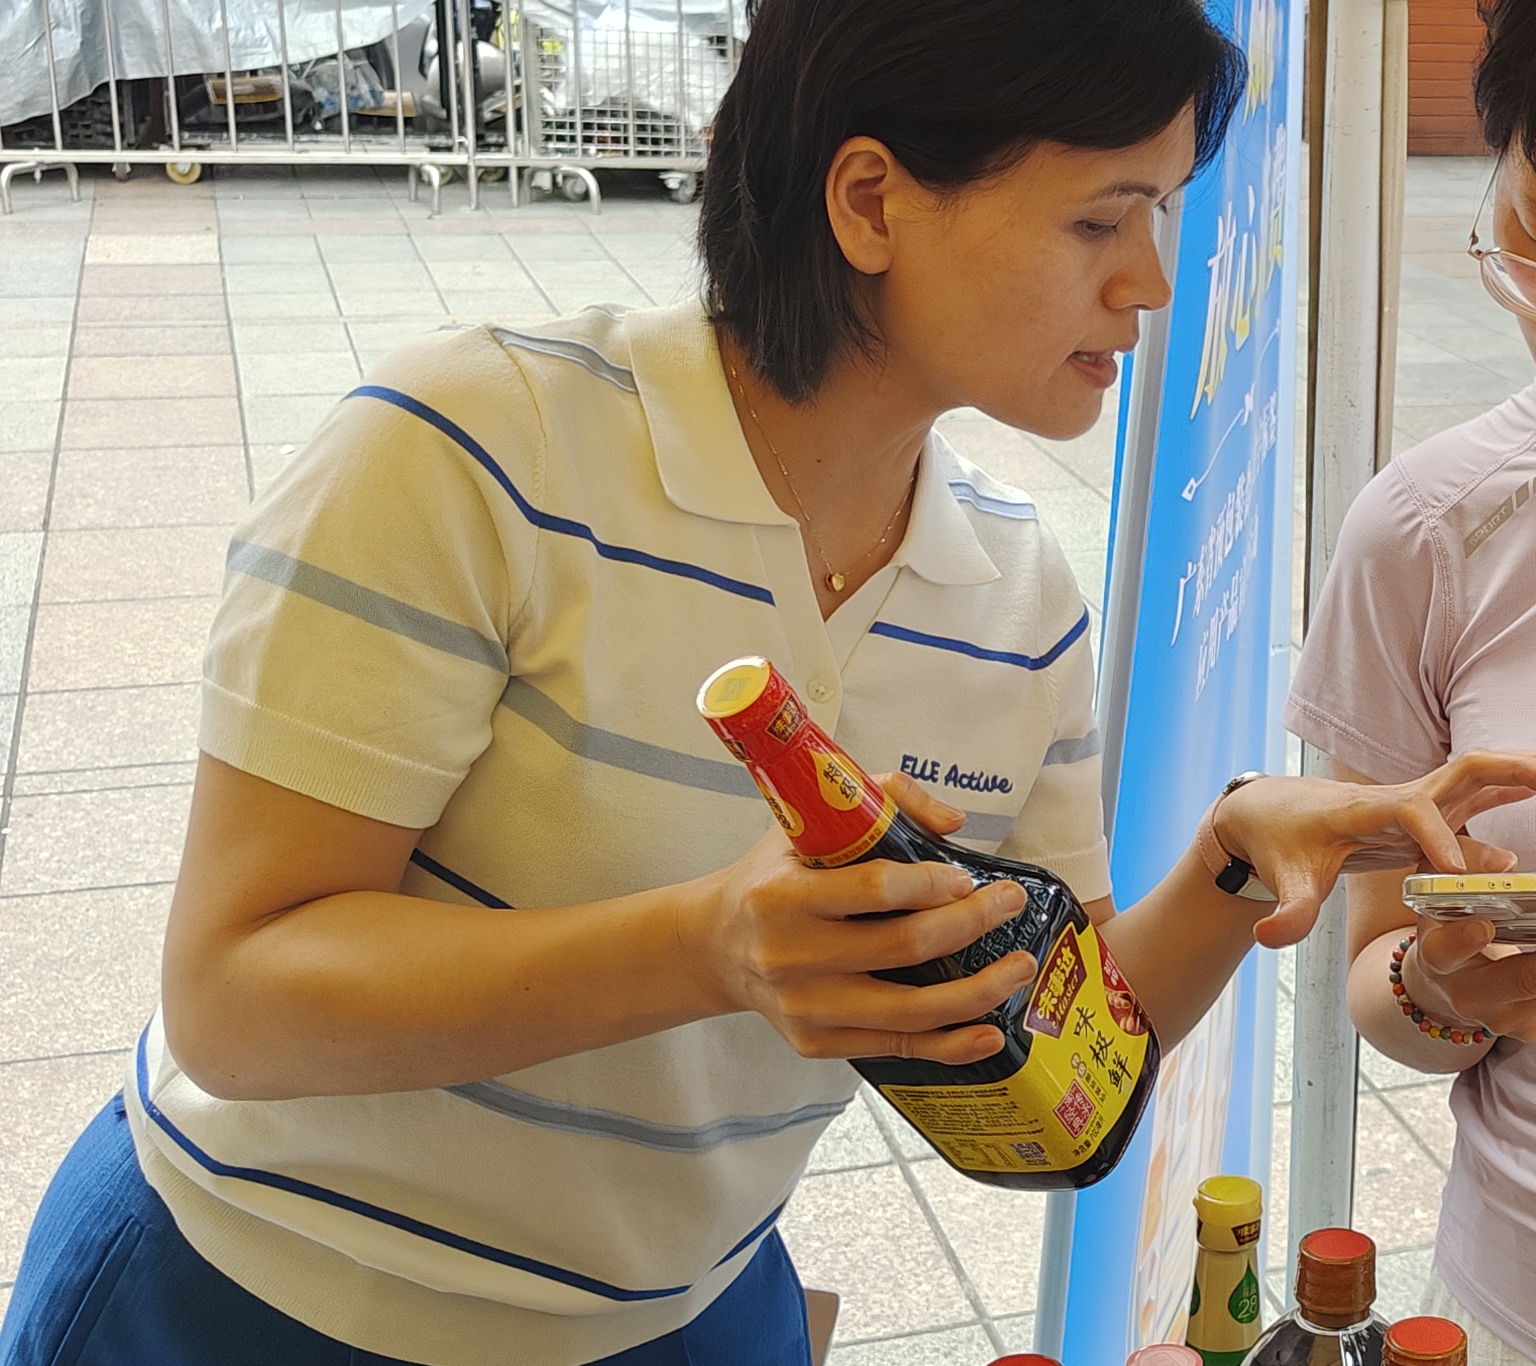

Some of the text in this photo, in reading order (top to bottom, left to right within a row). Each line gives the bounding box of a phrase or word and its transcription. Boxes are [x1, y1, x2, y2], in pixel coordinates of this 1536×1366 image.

[822, 761, 865, 804] 特级
[899, 754, 1013, 796] ELLE Active
[1038, 945, 1077, 1021] 味事达
[1073, 1005, 1133, 1095] 味极鲜
